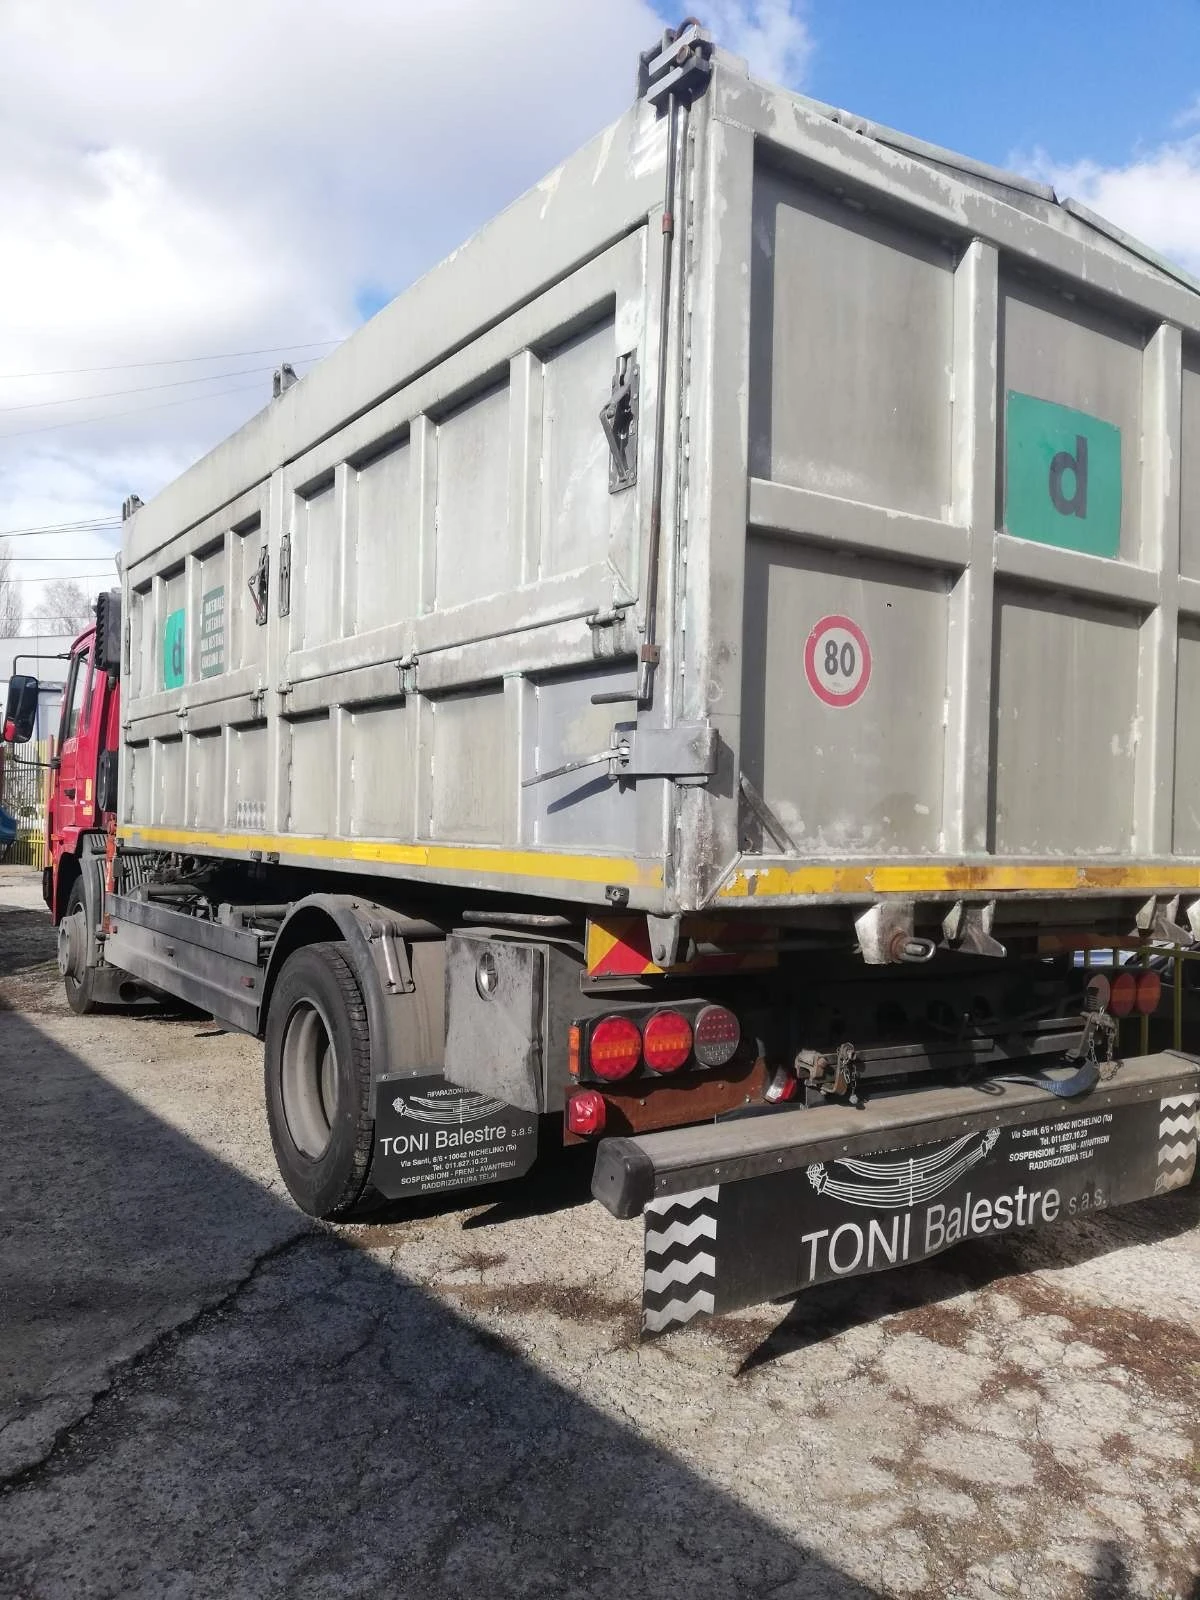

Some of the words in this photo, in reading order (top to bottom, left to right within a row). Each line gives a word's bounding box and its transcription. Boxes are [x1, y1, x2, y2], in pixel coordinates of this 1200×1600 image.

[1048, 435, 1088, 519] d
[824, 639, 856, 678] 80
[1011, 1131, 1021, 1140] Via
[1071, 1116, 1102, 1129] NICHELINO
[1102, 1113, 1113, 1124] (To)
[380, 1132, 429, 1156] TONI
[435, 1125, 507, 1149] Balestre
[511, 1126, 535, 1137] s.a.s.
[1009, 1147, 1056, 1162] SOSPENSIONI
[1059, 1142, 1077, 1154] FRENI
[1079, 1135, 1111, 1149] AVANTRENI
[1039, 1137, 1050, 1146] Tel.
[400, 1160, 411, 1168] Via
[469, 1146, 504, 1158] NICHELINO
[505, 1144, 517, 1153] (To)
[432, 1164, 444, 1172] Tel.
[1028, 1154, 1079, 1171] RADDRIZZATURA
[1079, 1149, 1094, 1159] TELAI
[400, 1172, 449, 1185] SOSPENSIONI
[454, 1167, 475, 1177] FRENI
[480, 1160, 516, 1173] AVANTRENI
[421, 1176, 478, 1190] RADDRIZZATURA
[479, 1172, 498, 1181] TELAI
[801, 1211, 910, 1281] TONI
[925, 1185, 1060, 1254] Balestre
[1068, 1188, 1106, 1217] s.a.s.
